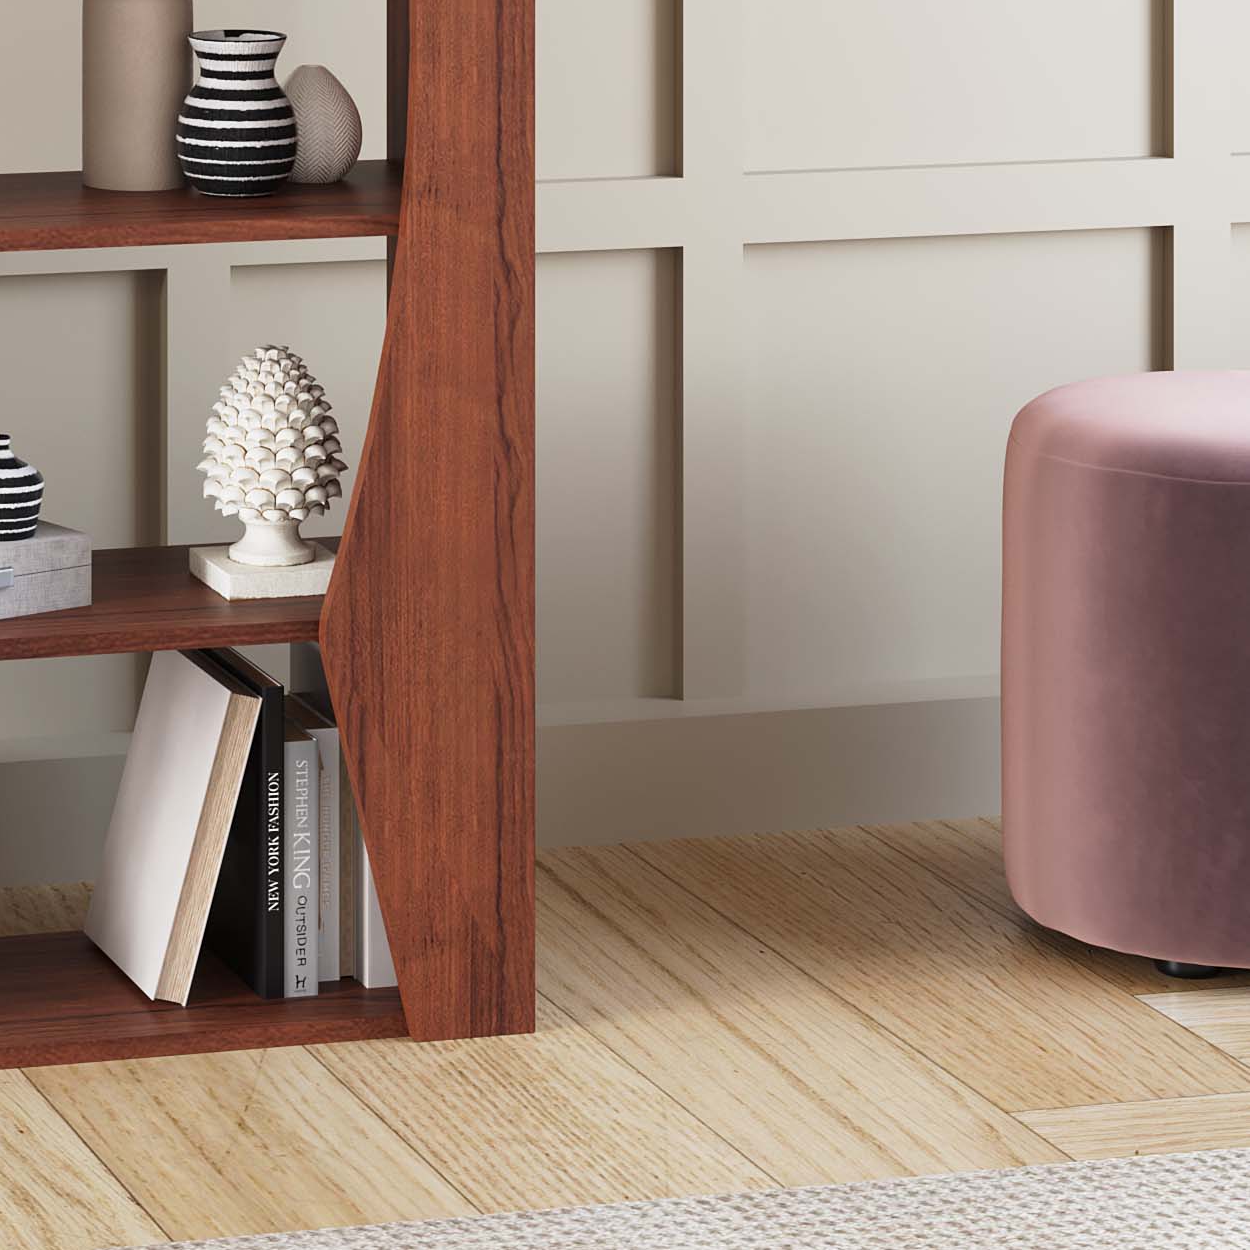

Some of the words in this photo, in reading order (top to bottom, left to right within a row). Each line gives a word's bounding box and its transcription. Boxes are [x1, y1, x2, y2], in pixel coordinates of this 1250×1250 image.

[267, 772, 280, 833] FASHION
[295, 760, 310, 831] STEPHEN
[267, 836, 280, 879] YORK
[293, 831, 311, 889] KING
[267, 879, 280, 912] NEW
[296, 895, 307, 967] OUTSIDER
